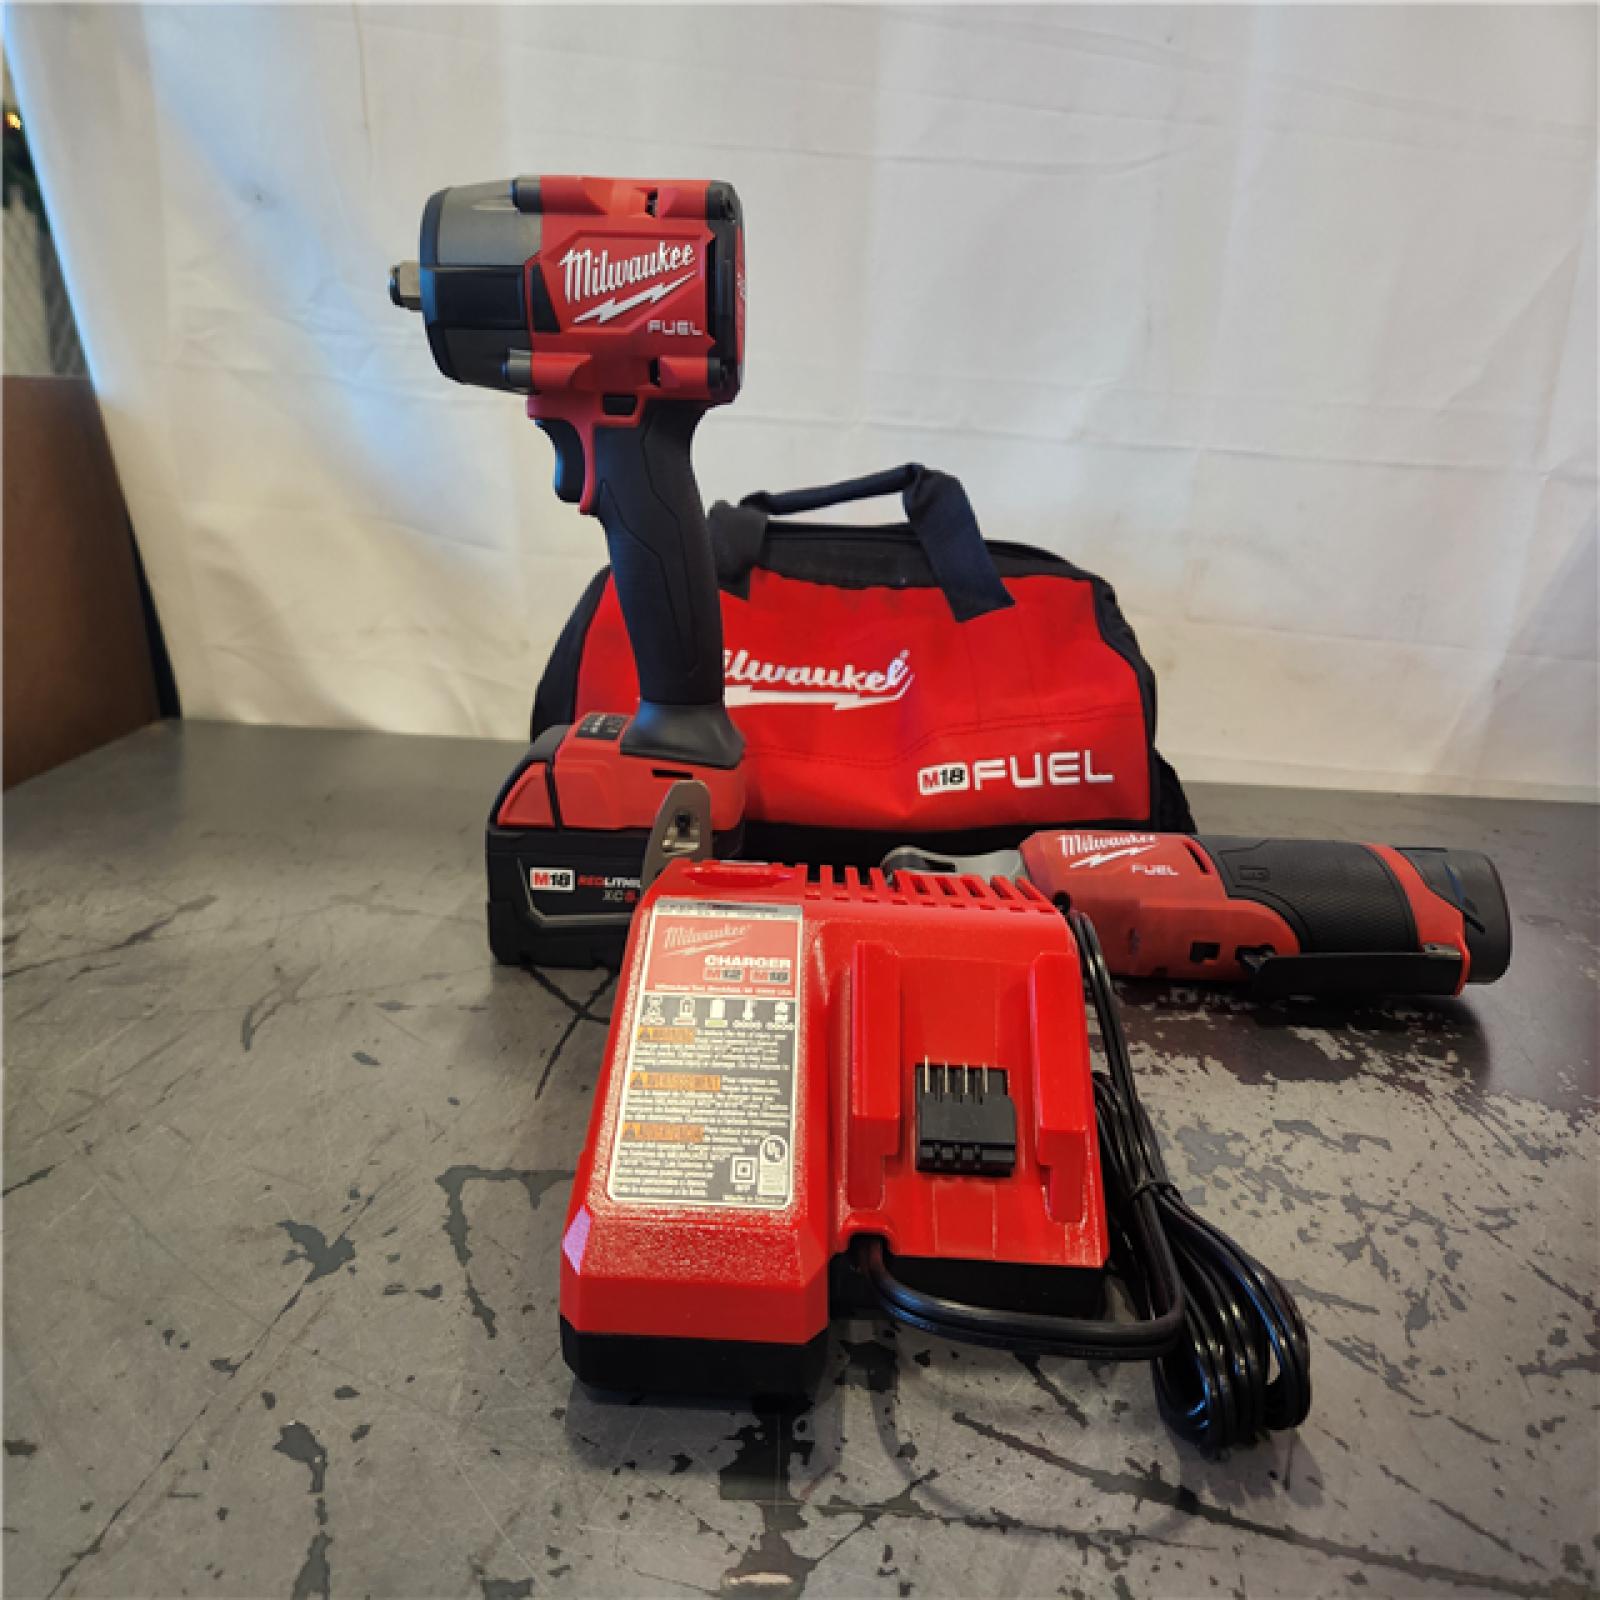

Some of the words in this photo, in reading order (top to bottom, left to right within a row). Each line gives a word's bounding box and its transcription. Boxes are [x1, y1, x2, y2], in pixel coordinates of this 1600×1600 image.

[559, 240, 697, 304] Milwaukee
[647, 319, 704, 337] FUEL
[723, 648, 910, 692] ilwaukee
[920, 764, 968, 793] M18
[974, 749, 1114, 791] FUEL
[1057, 833, 1157, 858] Milwaukee
[532, 870, 573, 890] M18
[1131, 863, 1180, 876] FUEL
[663, 922, 752, 952] Milwaukee
[704, 954, 792, 970] CHARGER
